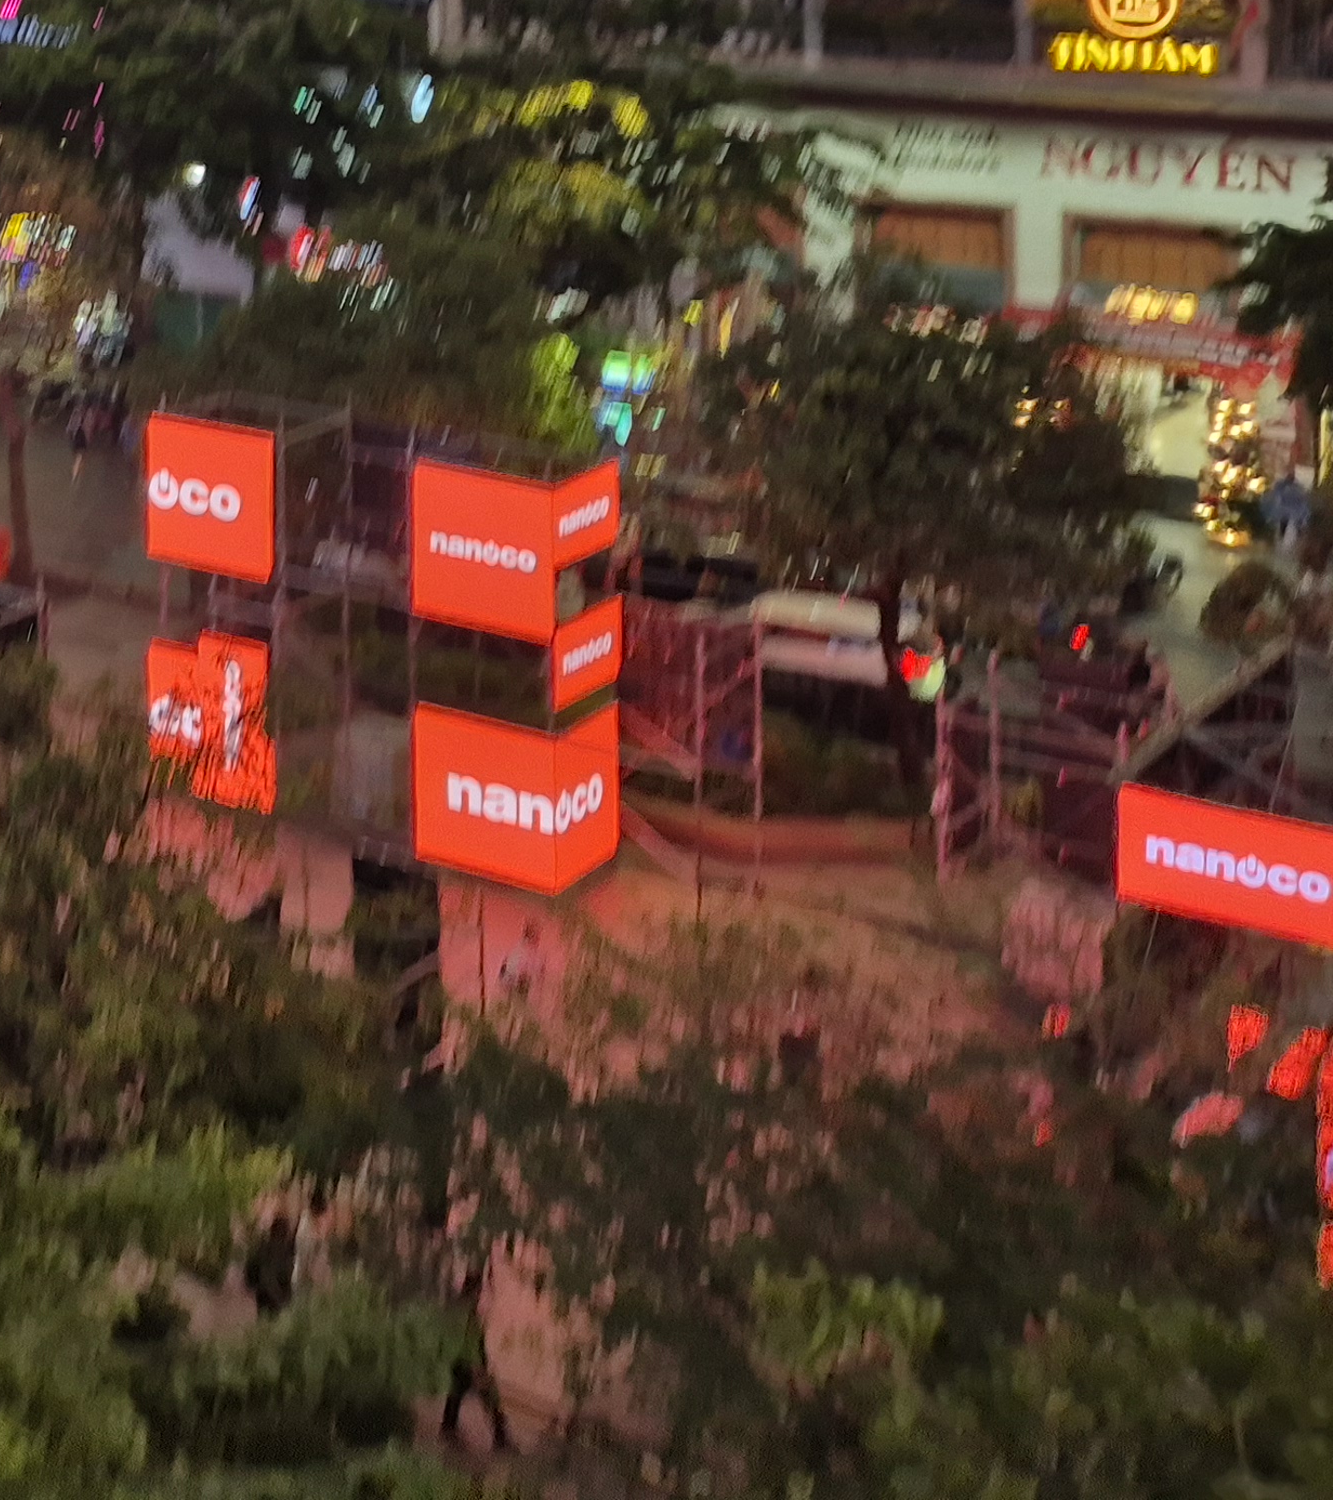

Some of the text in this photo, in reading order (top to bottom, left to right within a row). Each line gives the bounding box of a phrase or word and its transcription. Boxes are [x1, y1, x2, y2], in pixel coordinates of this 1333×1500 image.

[558, 494, 611, 539] nanoco
[430, 529, 538, 574] nanoco
[562, 630, 613, 677] nanoco
[446, 770, 604, 837] nanoco
[1145, 832, 1332, 905] nanoco
